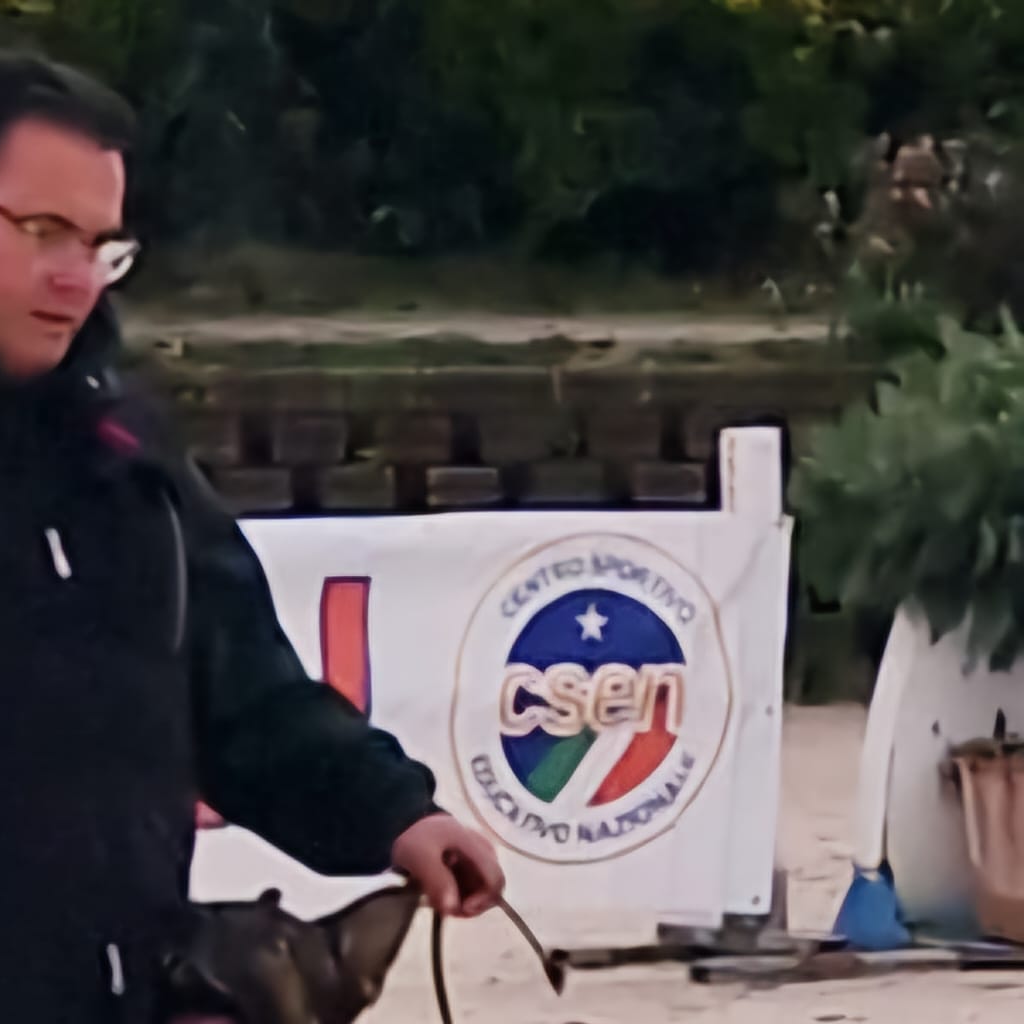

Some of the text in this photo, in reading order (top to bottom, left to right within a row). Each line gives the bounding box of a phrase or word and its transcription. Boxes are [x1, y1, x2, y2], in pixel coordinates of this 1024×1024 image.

[592, 552, 695, 624] SPORTIVO
[500, 662, 685, 738] csen
[577, 752, 695, 843] NAZIONALE
